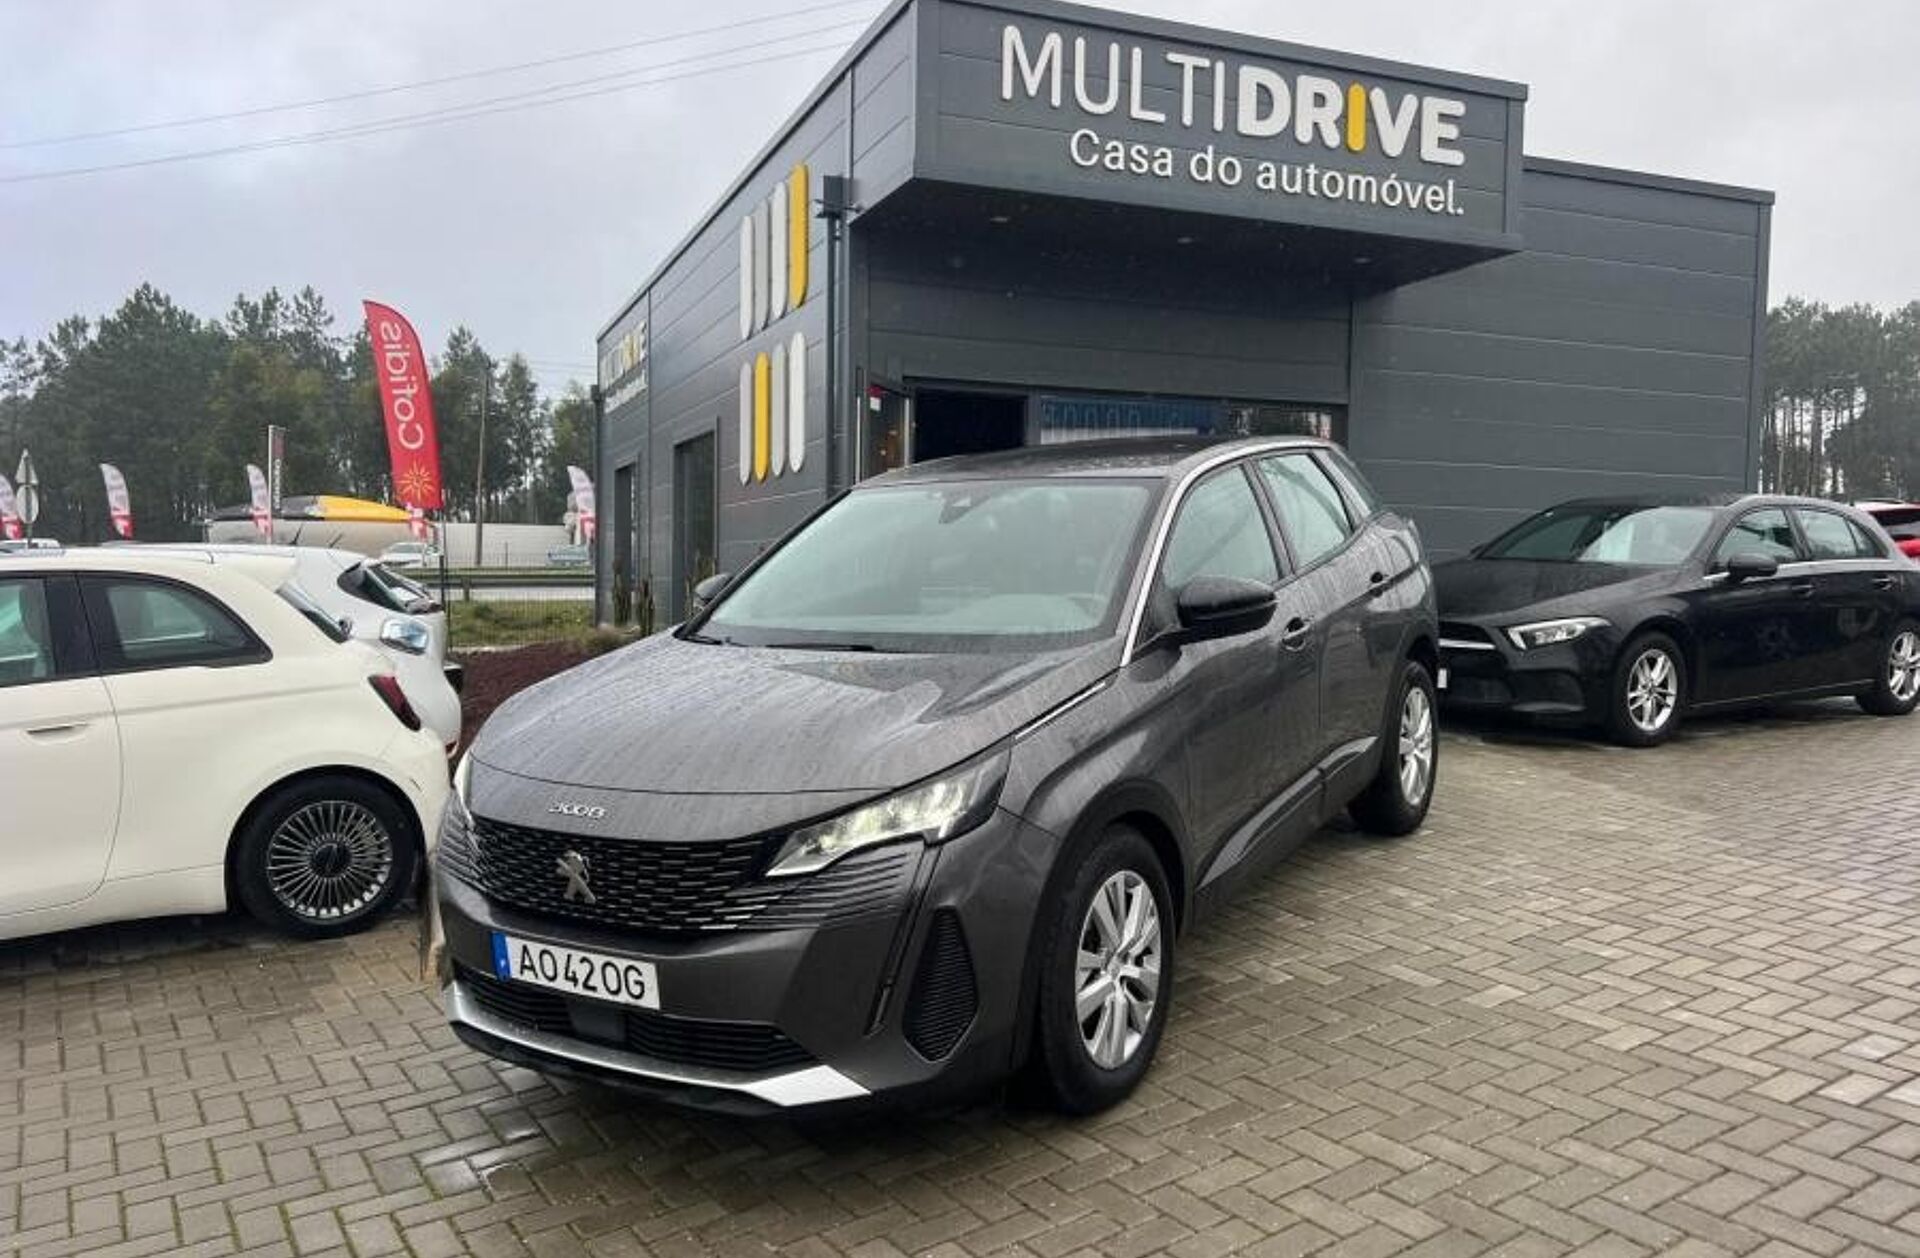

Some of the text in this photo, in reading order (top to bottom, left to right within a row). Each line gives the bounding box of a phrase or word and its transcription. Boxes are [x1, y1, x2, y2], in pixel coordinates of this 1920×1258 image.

[1002, 25, 1466, 167] MULTIDRIVE
[1070, 129, 1465, 216] Casa do automóvel.
